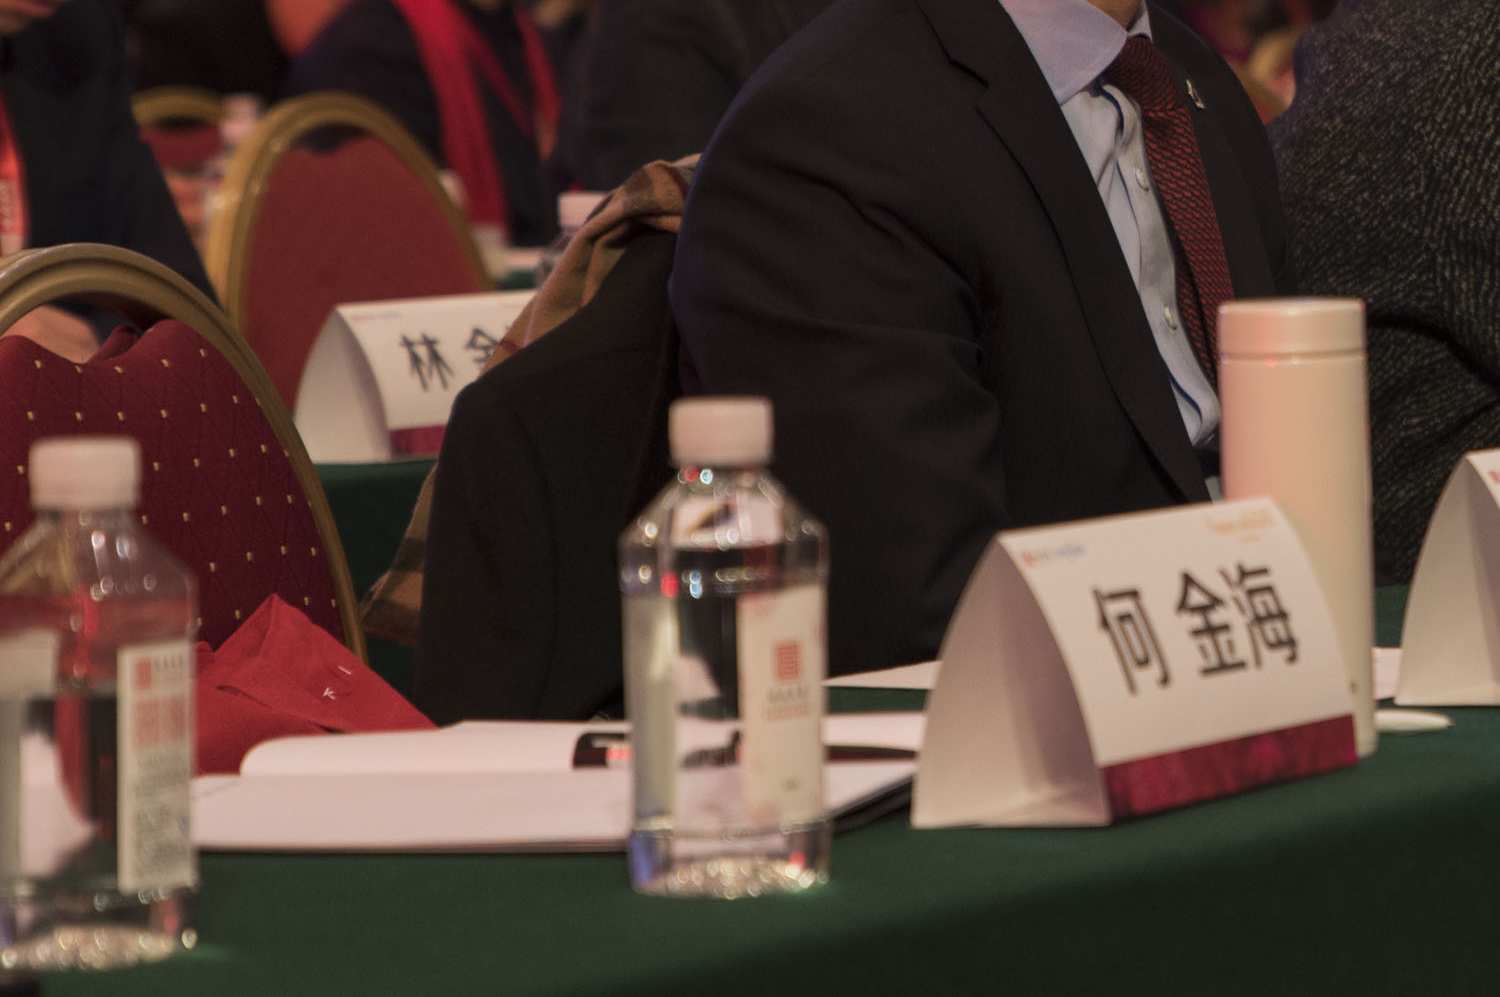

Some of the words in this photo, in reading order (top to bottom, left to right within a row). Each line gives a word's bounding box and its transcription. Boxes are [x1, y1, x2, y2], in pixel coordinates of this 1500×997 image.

[400, 323, 512, 391] 林金
[1092, 560, 1298, 696] 何金海
